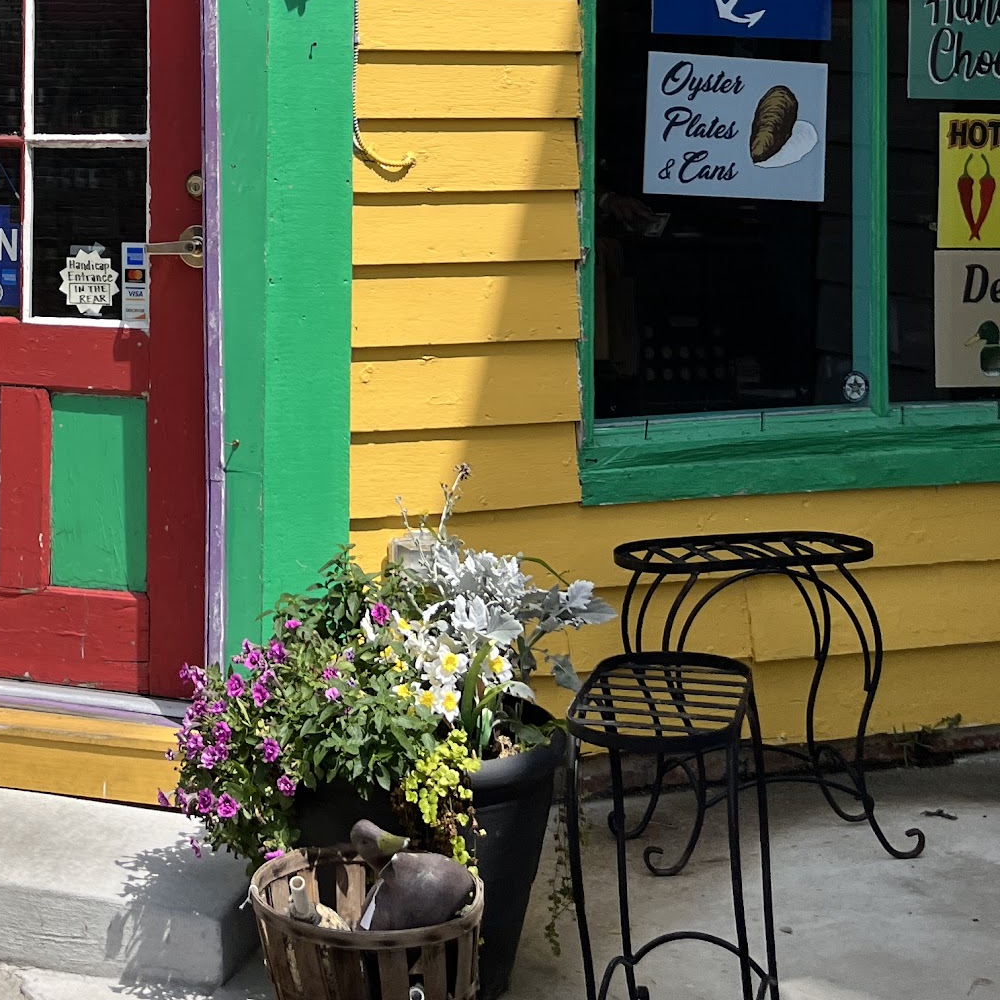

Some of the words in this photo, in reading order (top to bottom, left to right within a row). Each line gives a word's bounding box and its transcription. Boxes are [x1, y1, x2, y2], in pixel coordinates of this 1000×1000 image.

[660, 60, 745, 101] Oyster
[663, 106, 739, 142] Plates
[946, 118, 1000, 150] HOT
[658, 158, 675, 180] &
[678, 151, 739, 185] Cans
[68, 271, 113, 282] Entrance
[69, 260, 110, 275] Handicap
[74, 285, 85, 293] IN
[88, 285, 107, 293] THE
[79, 294, 107, 304] REAR
